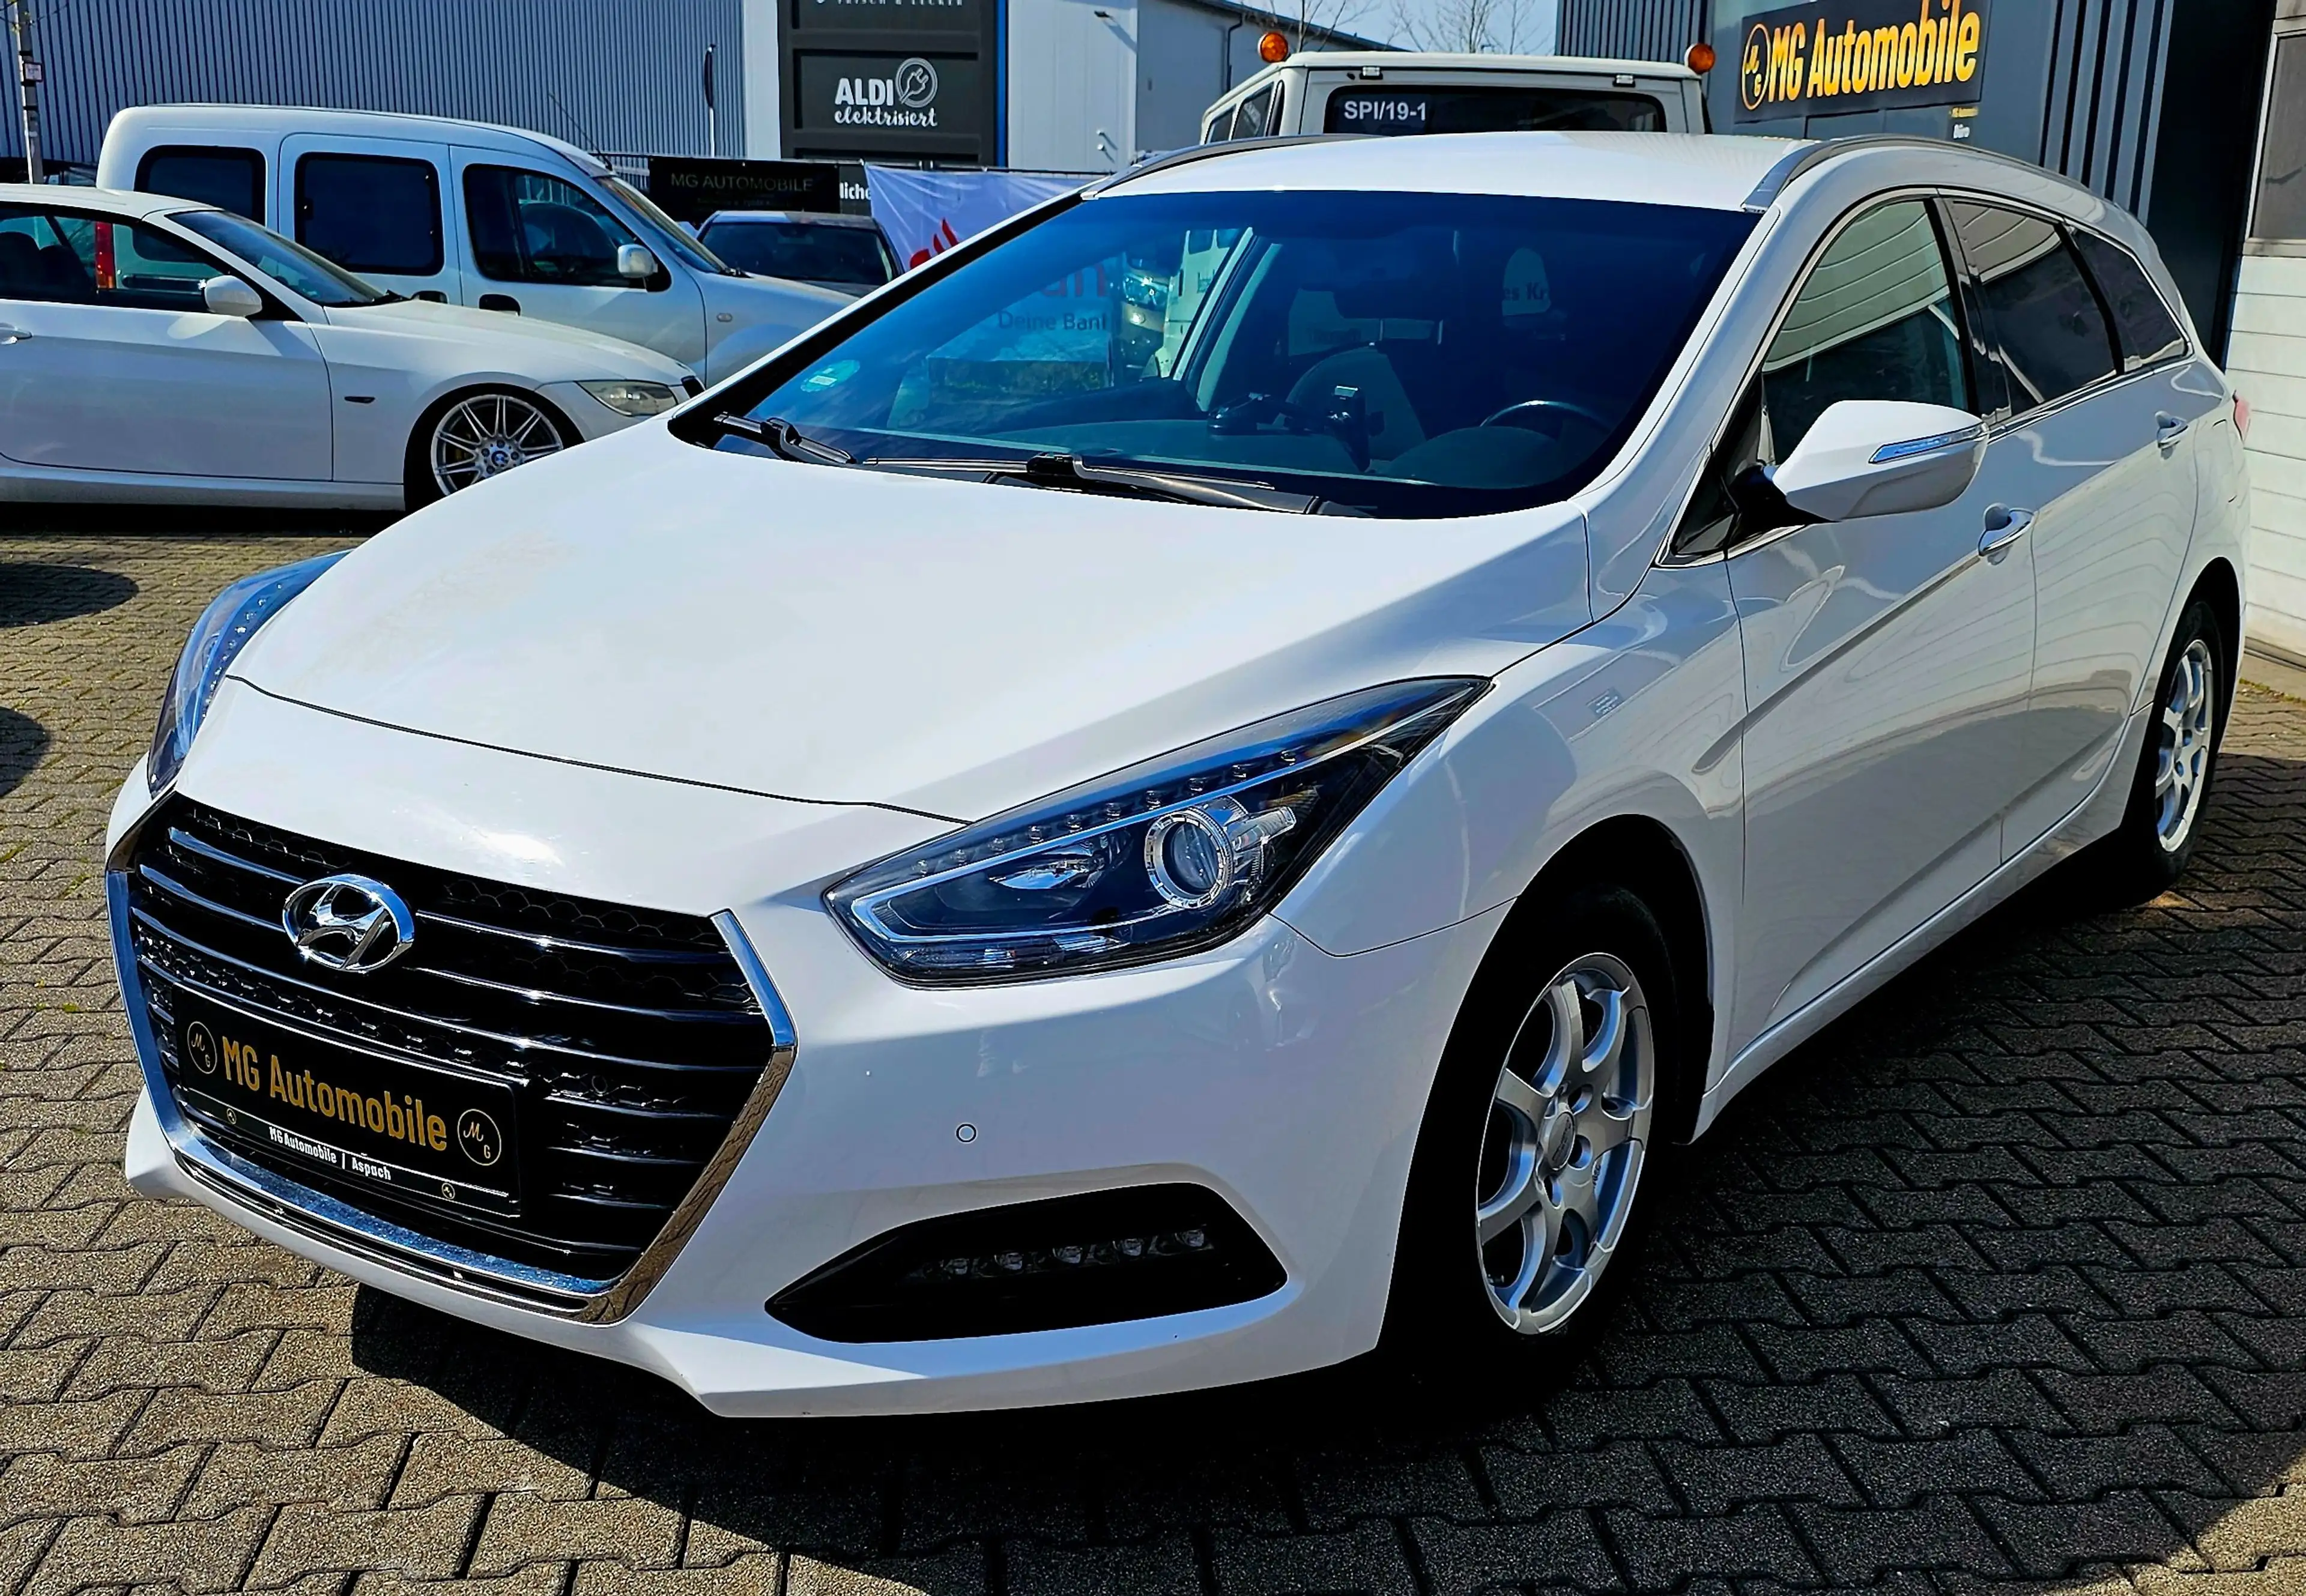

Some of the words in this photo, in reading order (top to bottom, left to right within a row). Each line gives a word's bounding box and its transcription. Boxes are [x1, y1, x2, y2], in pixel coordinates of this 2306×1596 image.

[1769, 22, 1806, 103] MG
[1806, 0, 1981, 98] Automobile
[835, 77, 894, 106] ALDI
[834, 106, 938, 127] elektrisiert
[1344, 100, 1426, 121] SPI/19-1
[670, 172, 699, 189] MG
[703, 175, 814, 193] AUTOMOBILE
[999, 310, 1056, 331] Deine
[222, 1035, 261, 1092] MG
[270, 1054, 447, 1152] Automobile
[269, 1126, 283, 1144] MG
[283, 1132, 337, 1164] Automobile
